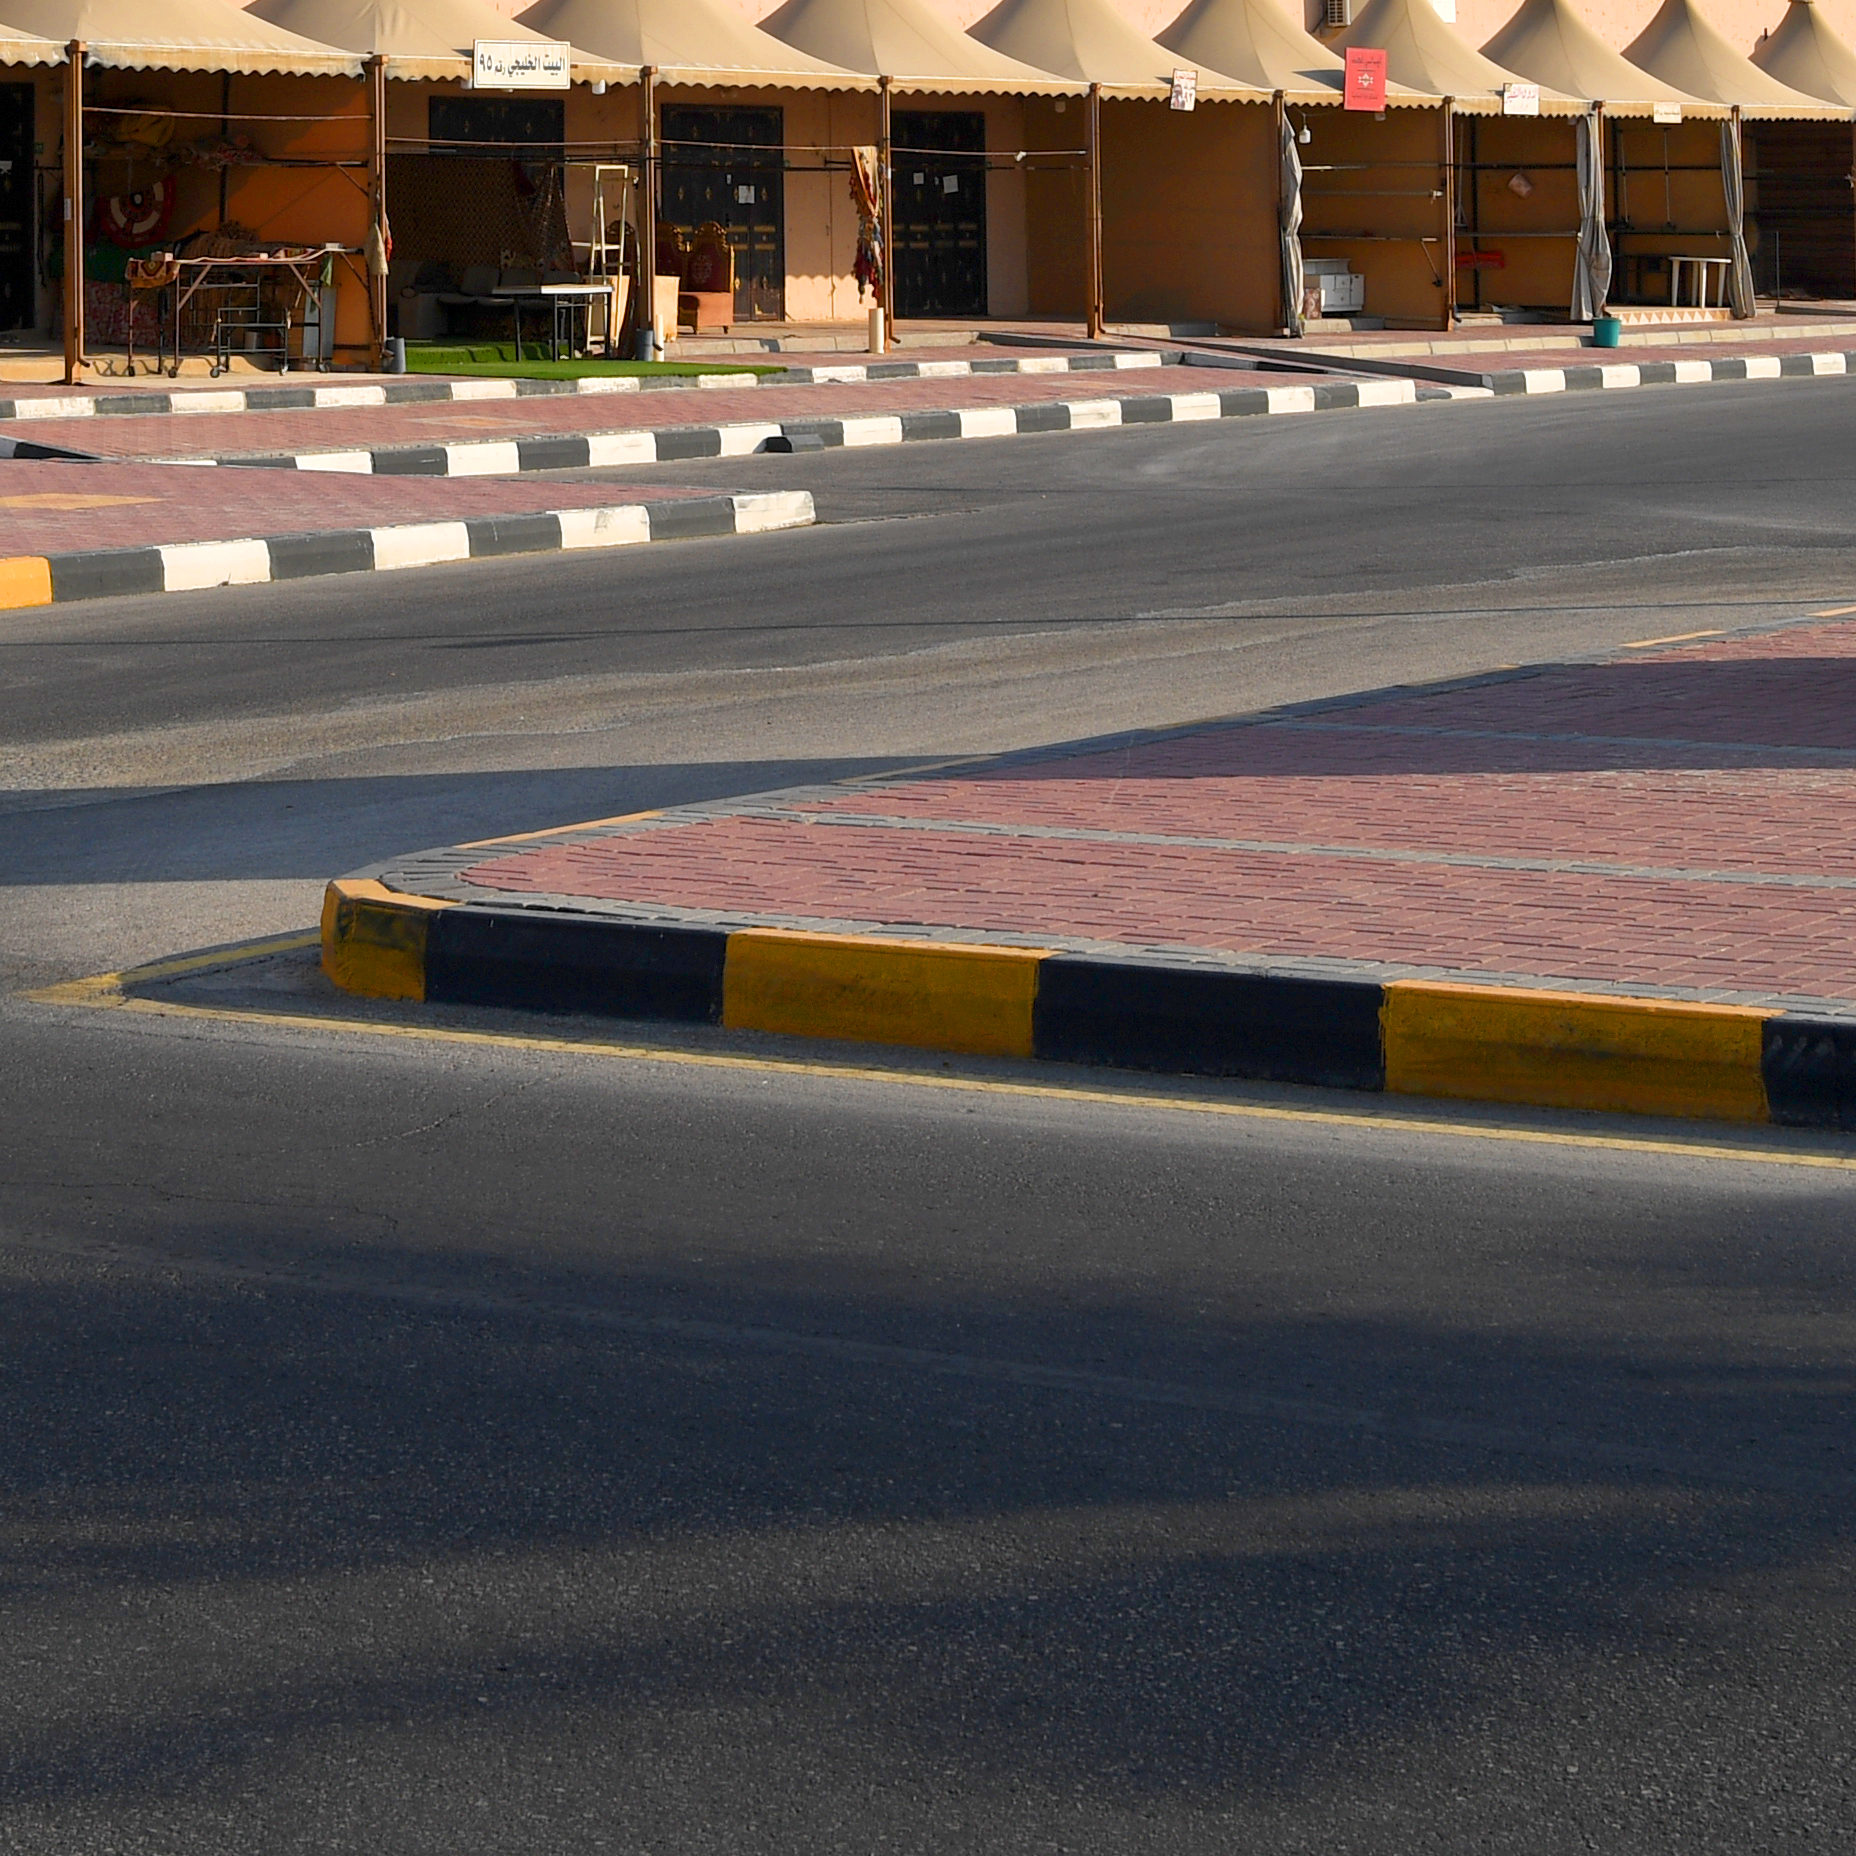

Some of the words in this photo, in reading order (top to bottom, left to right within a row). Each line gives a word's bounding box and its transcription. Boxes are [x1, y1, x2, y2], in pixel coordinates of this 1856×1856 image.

[479, 52, 493, 72] ٩٥
[507, 53, 541, 78] الخليجي
[542, 53, 566, 77] البيت
